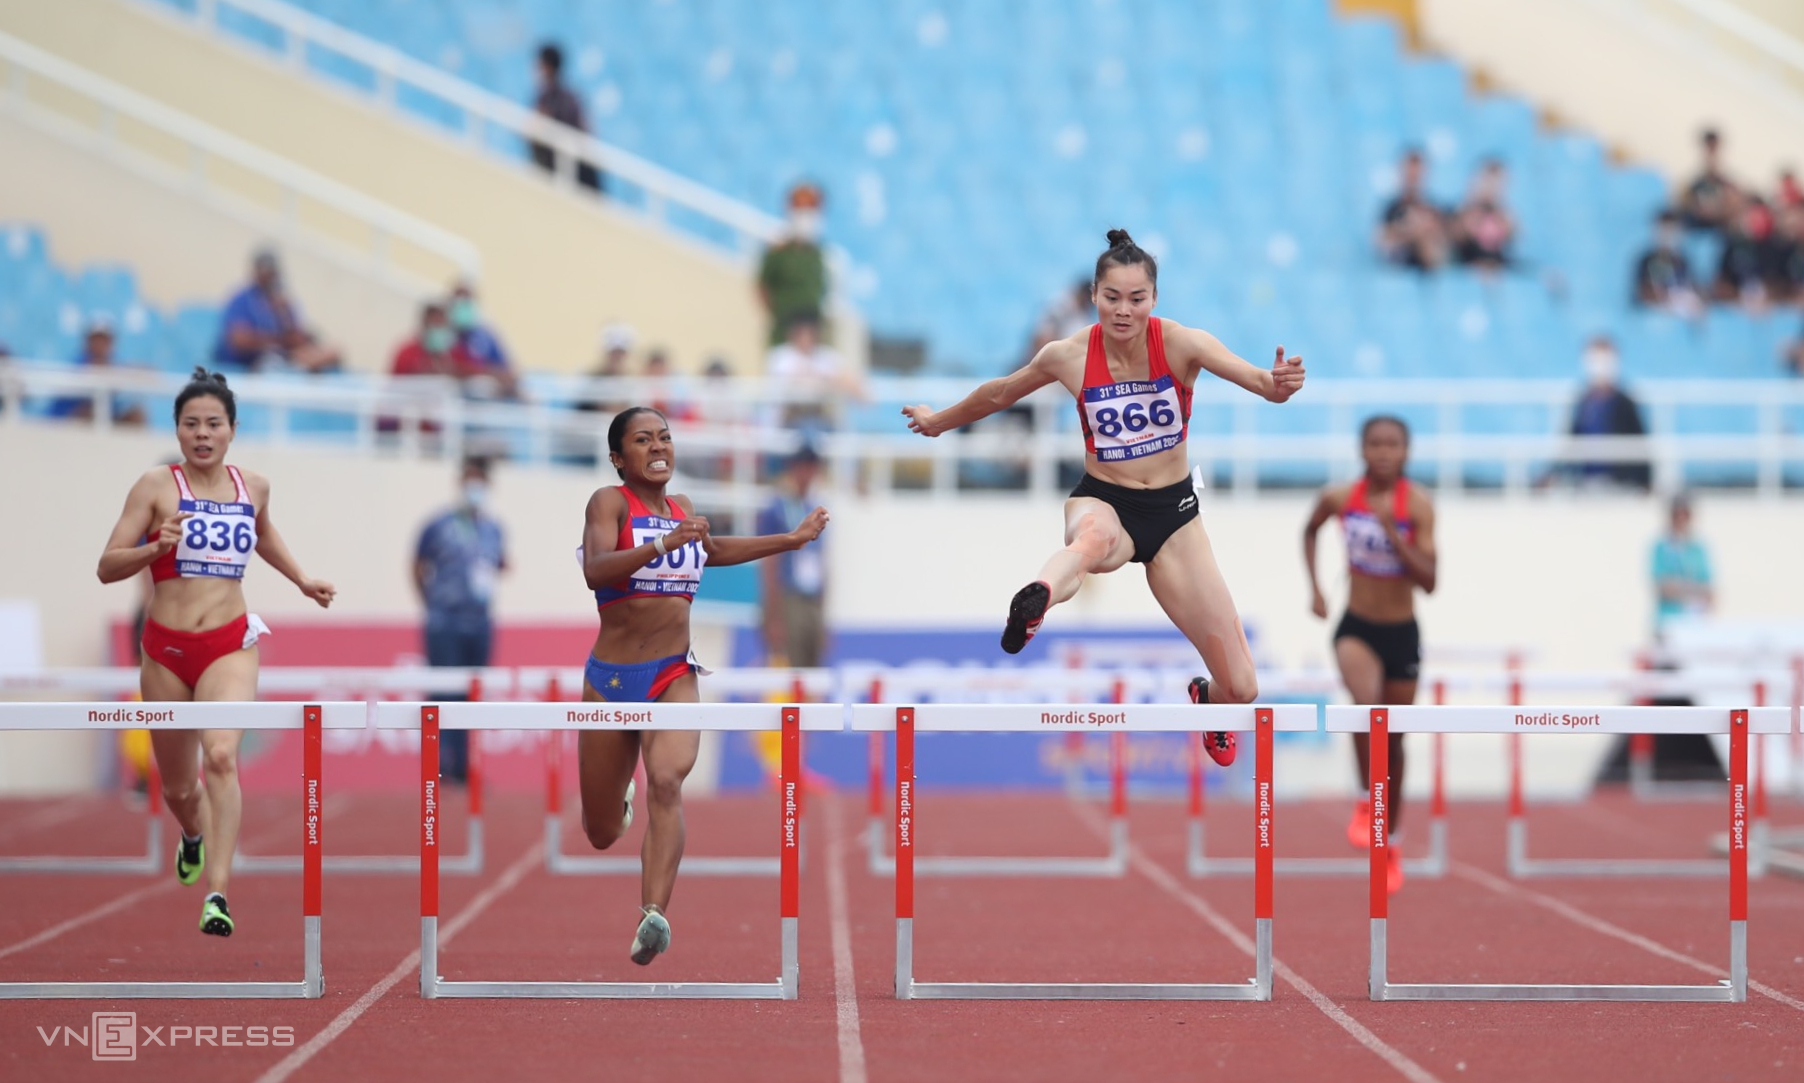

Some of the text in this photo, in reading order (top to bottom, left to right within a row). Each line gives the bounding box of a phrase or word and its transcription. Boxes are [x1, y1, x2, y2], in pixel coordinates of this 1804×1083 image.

[1115, 384, 1131, 396] SEA
[1132, 382, 1158, 393] Games
[1095, 399, 1175, 438] 866
[1103, 449, 1125, 460] HANOI
[1131, 440, 1163, 457] VIETNAM
[1126, 433, 1154, 444] VIETNAM
[185, 518, 252, 554] 836
[635, 580, 657, 591] HANOI
[662, 581, 687, 592] VIETNAM
[135, 710, 174, 725] Sport
[613, 711, 652, 725] Sport
[1088, 712, 1126, 727] Sport
[1562, 714, 1600, 729] Sport
[306, 815, 318, 845] Sport
[424, 816, 435, 846] Sport
[784, 818, 795, 847] Sport
[899, 817, 910, 846] Sport
[1258, 818, 1269, 847] Sport
[1373, 818, 1384, 847] Sport
[1732, 820, 1744, 849] Sport
